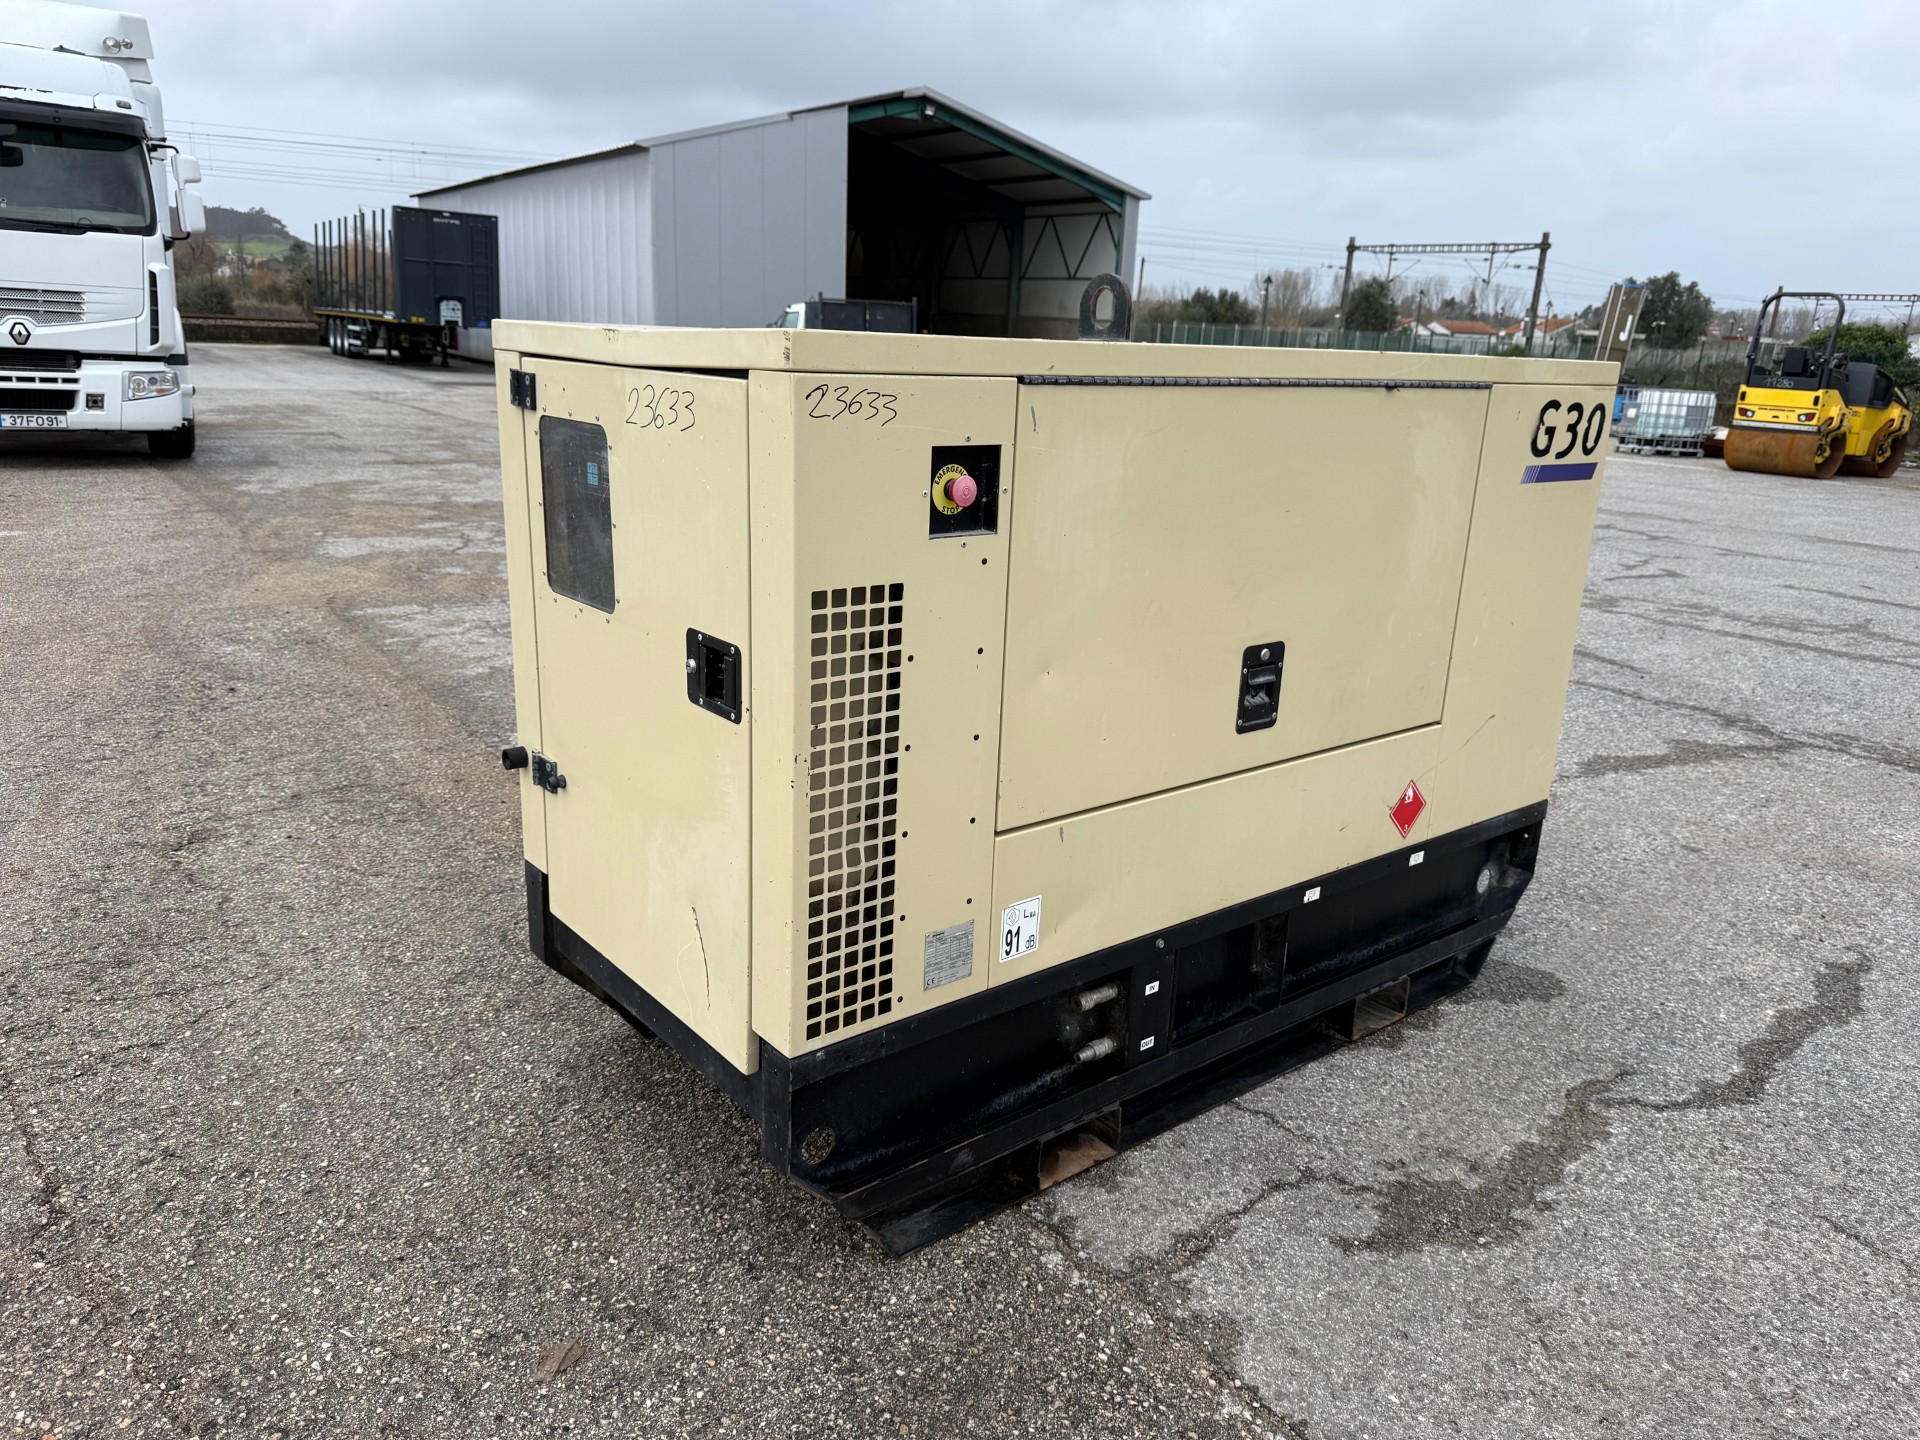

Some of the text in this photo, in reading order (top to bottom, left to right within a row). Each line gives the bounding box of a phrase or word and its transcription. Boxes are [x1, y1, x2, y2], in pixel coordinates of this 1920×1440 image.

[625, 384, 696, 432] 23633
[805, 383, 898, 427] 23633
[1530, 399, 1606, 460] G30
[934, 465, 967, 485] EMERGEN
[941, 505, 960, 514] STOP
[1403, 824, 1409, 832] 3
[1005, 925, 1035, 957] 91 dB
[1148, 984, 1156, 992] IN
[1141, 1038, 1153, 1048] OUT
